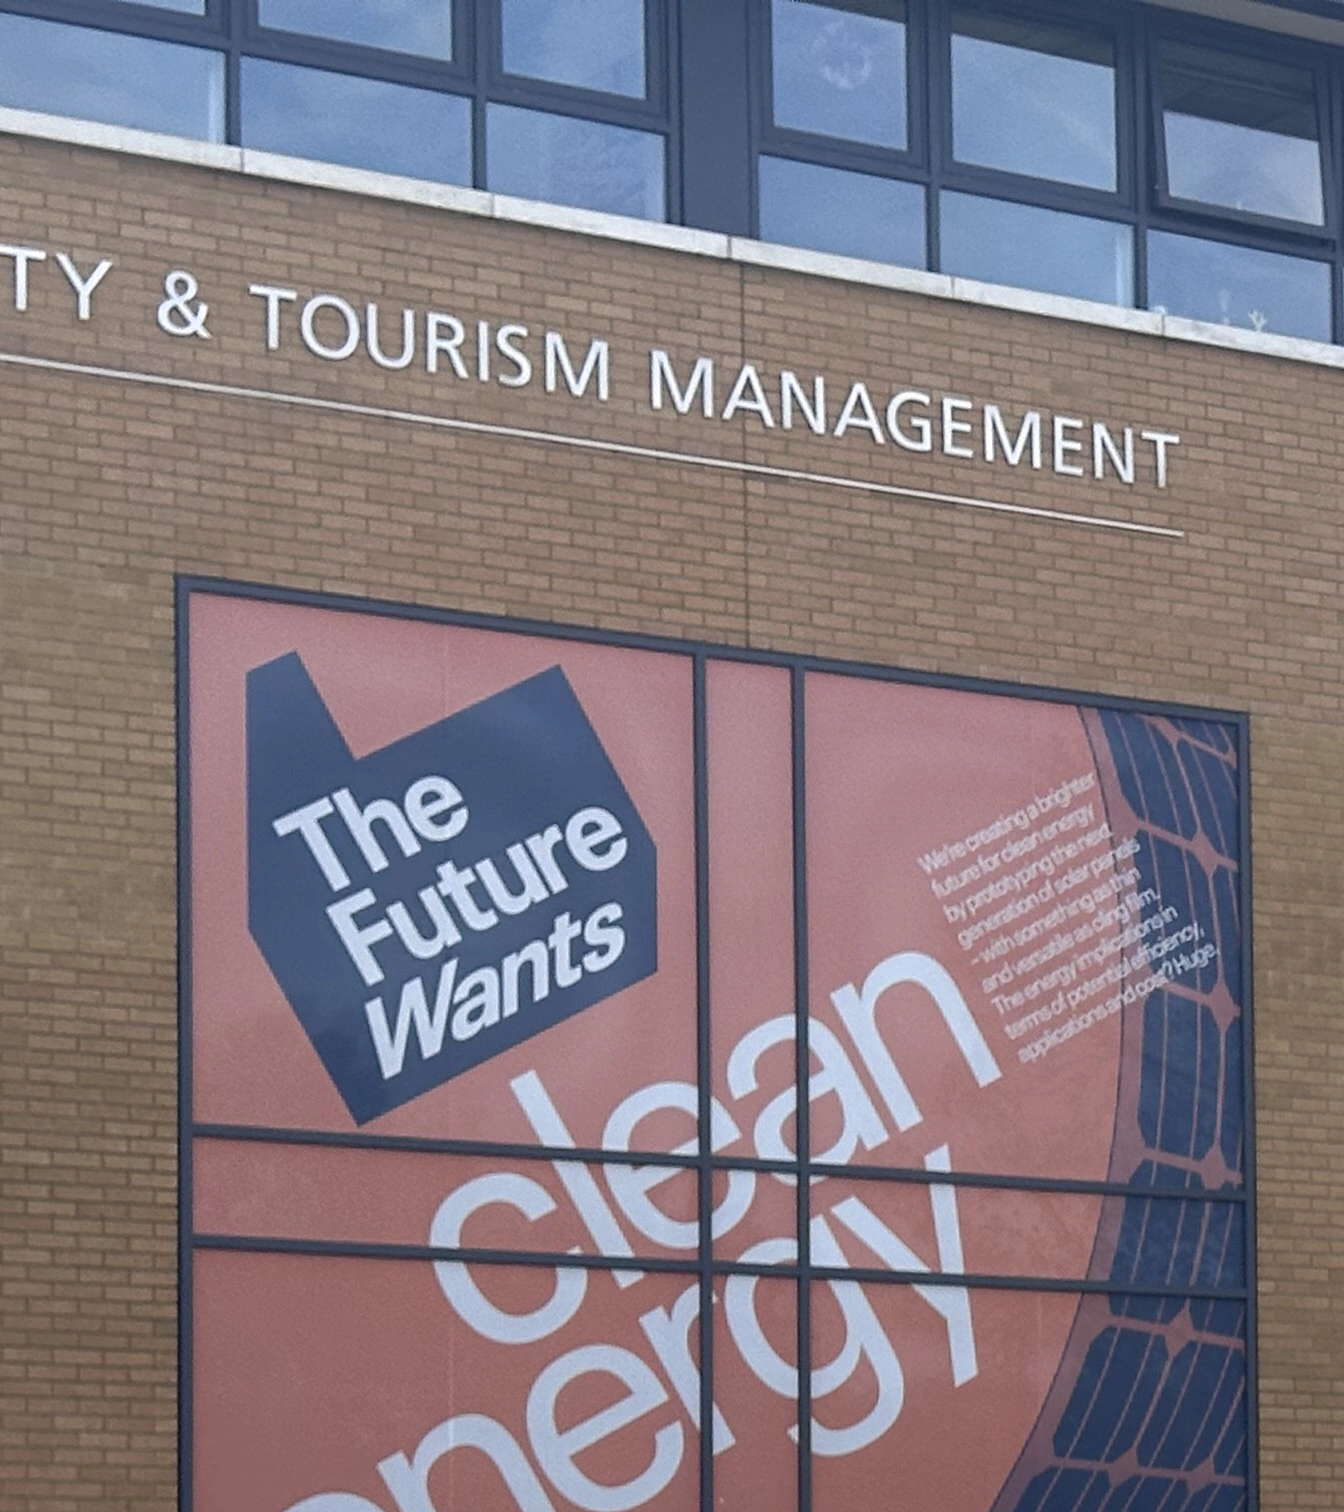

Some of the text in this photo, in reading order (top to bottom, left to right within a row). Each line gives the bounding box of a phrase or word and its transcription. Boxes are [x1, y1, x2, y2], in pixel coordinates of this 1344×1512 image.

[0, 245, 1181, 490] TY & TOURISM MANAGEMENT
[272, 773, 470, 892] The
[326, 805, 628, 987] Future
[364, 902, 626, 1080] Wants
[428, 951, 1003, 1345] clean
